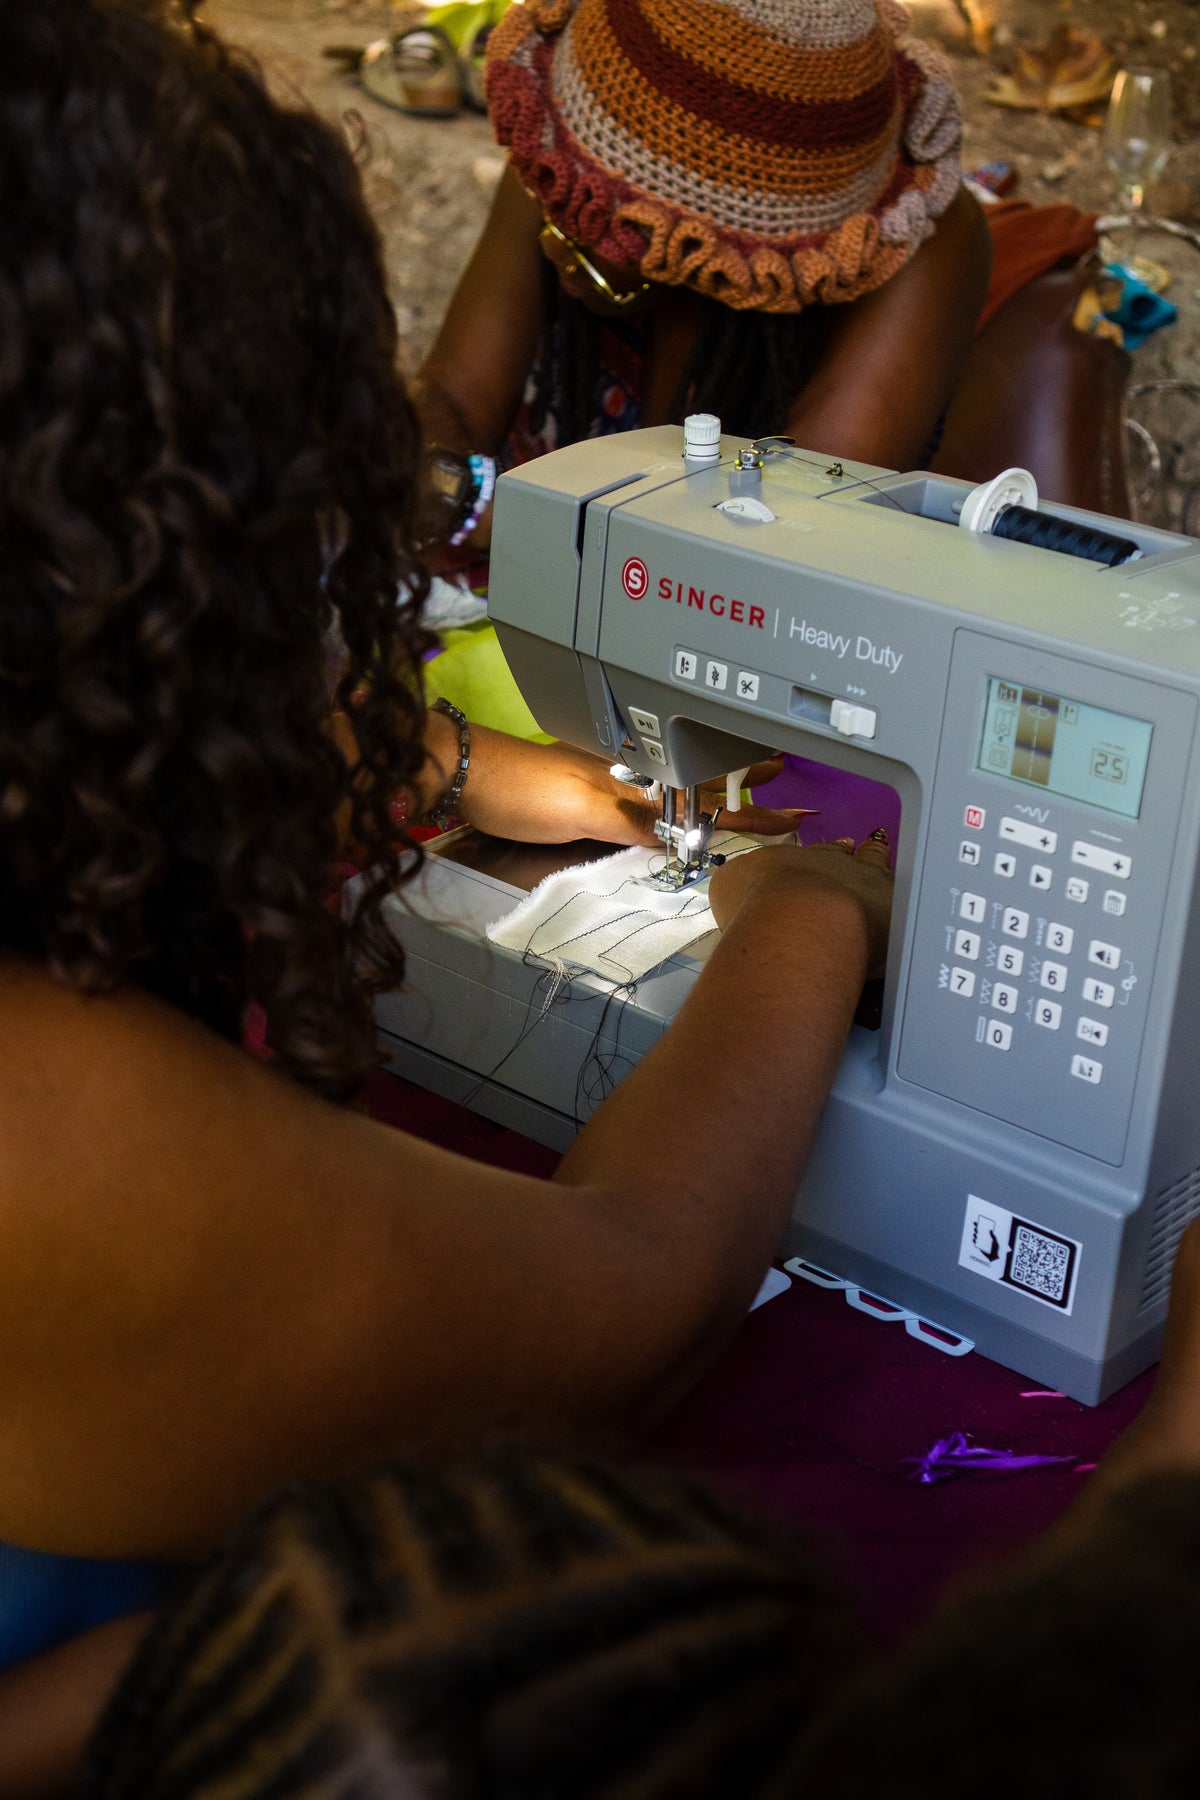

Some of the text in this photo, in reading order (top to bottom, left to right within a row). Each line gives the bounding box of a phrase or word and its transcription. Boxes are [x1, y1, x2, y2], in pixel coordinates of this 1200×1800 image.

[658, 578, 903, 674] SINGER Heavy Duty
[968, 901, 977, 915] 1
[1009, 916, 1020, 931] 2
[961, 939, 972, 953] 4
[1054, 932, 1064, 946] 3
[1004, 954, 1014, 969] 5
[957, 975, 967, 989] 7
[1047, 971, 1057, 985] 6
[998, 992, 1008, 1007] 8
[1042, 1008, 1052, 1022] 9
[993, 1029, 1003, 1043] 0
